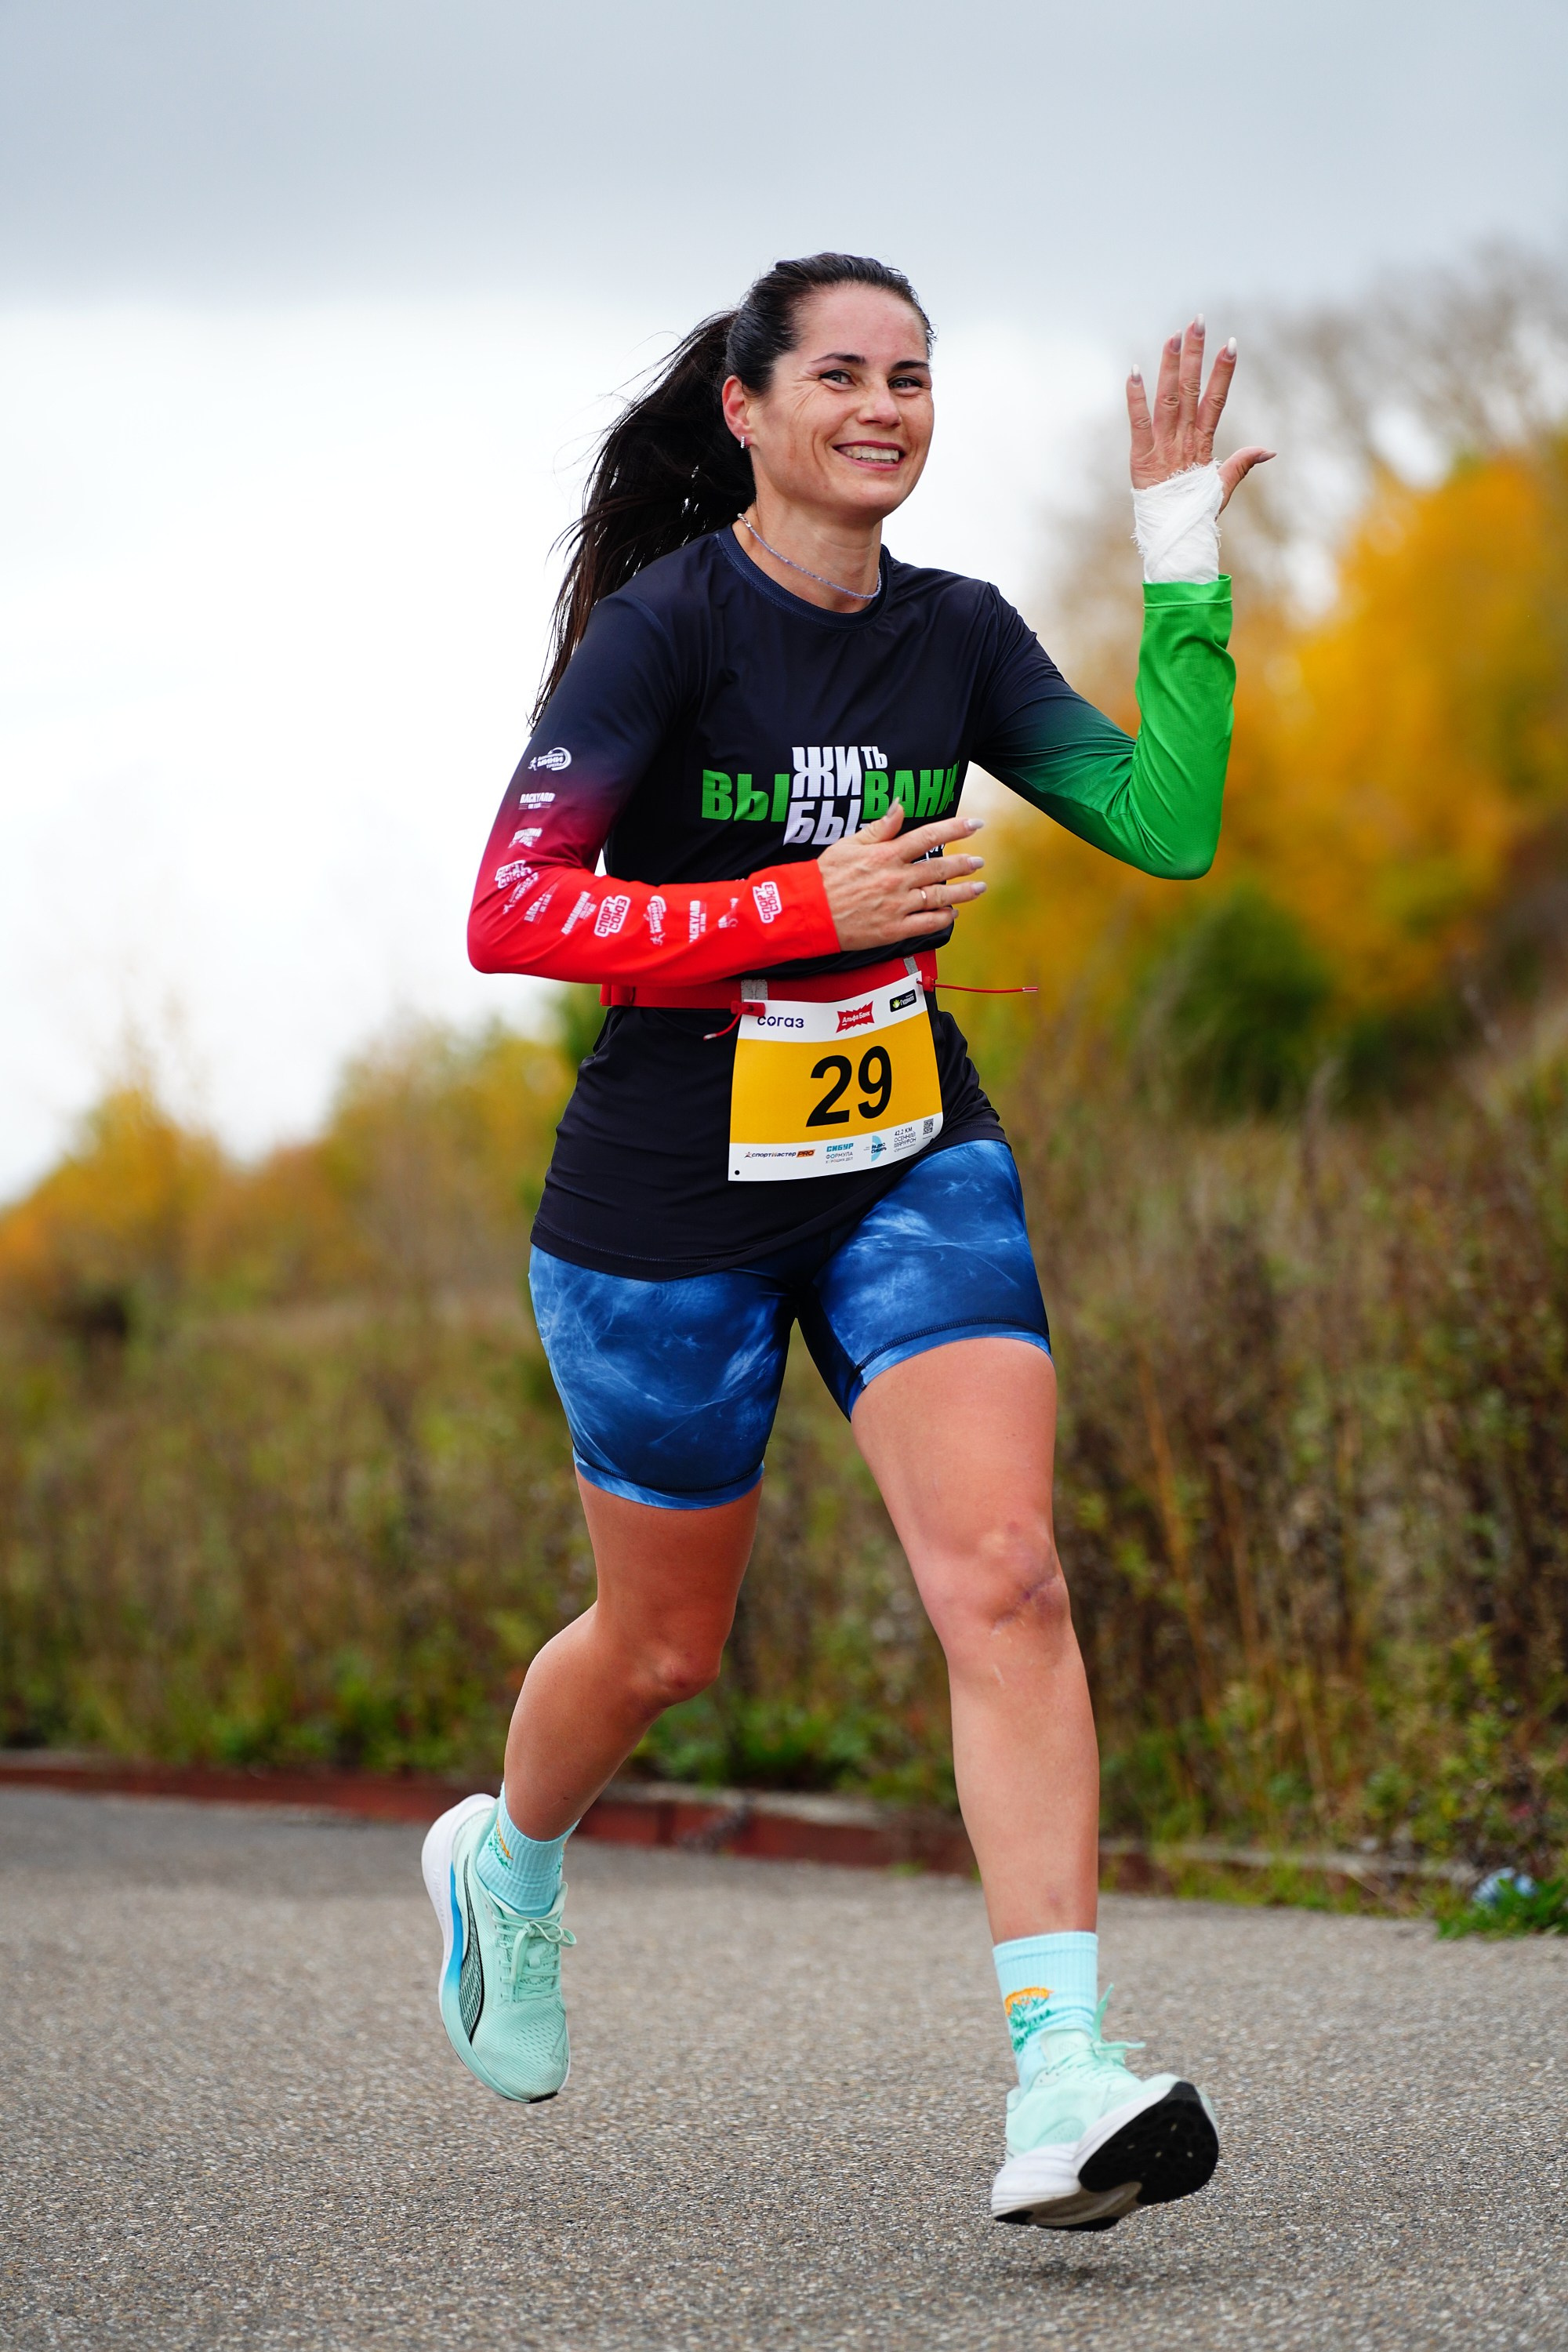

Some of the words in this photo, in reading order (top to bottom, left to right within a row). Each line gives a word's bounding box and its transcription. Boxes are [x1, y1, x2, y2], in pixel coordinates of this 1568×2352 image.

[520, 792, 556, 804] BACKYARD
[609, 897, 628, 931] СОЮЗ
[755, 888, 772, 921] СПОРТ
[764, 884, 779, 913] СОЮЗ
[597, 898, 615, 935] СПОРТ
[689, 900, 701, 943] ACKYARD
[842, 1014, 859, 1025] Альфа
[858, 1011, 871, 1019] Банк
[806, 1045, 892, 1127] 29
[826, 1142, 854, 1152] СИБУР
[826, 1151, 853, 1160] ФОРМУЛА
